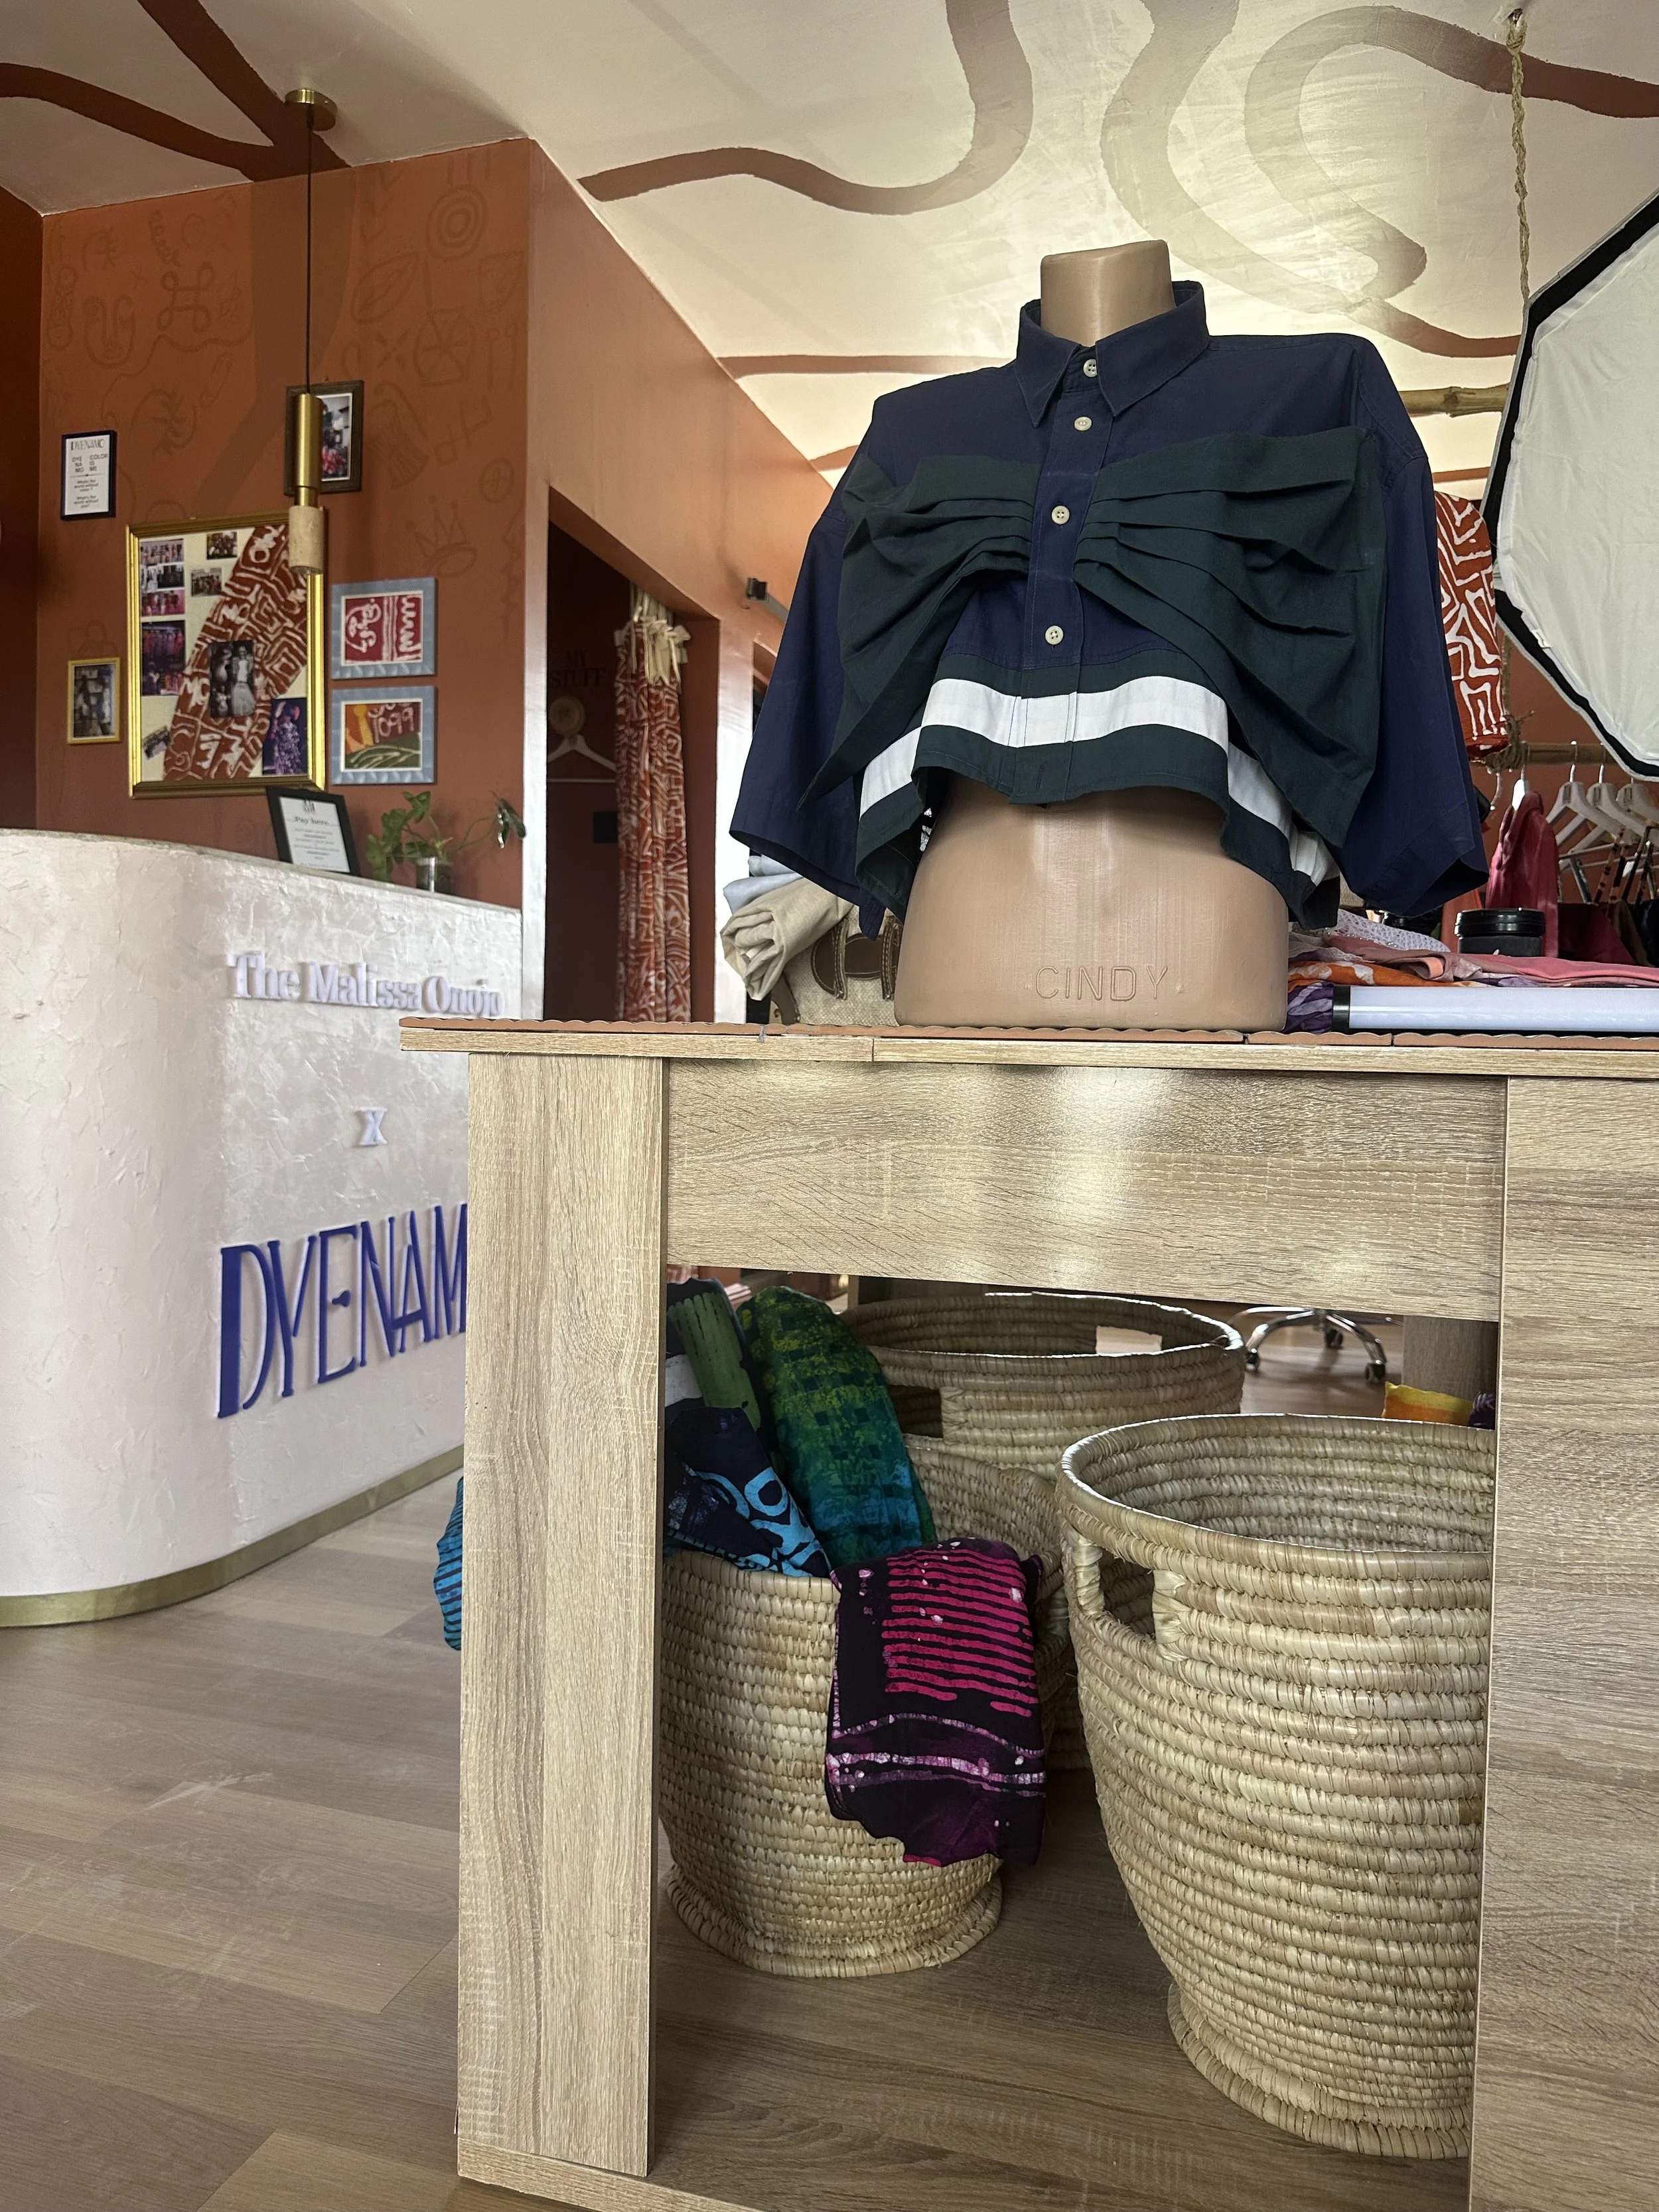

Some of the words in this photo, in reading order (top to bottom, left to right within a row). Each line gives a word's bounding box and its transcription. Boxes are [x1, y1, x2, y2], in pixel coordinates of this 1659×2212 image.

[227, 950, 300, 999] The
[303, 962, 421, 1010] Malissa
[422, 975, 504, 1017] Onojo
[1035, 966, 1168, 1001] CINDY
[217, 1203, 467, 1418] DYENAM
